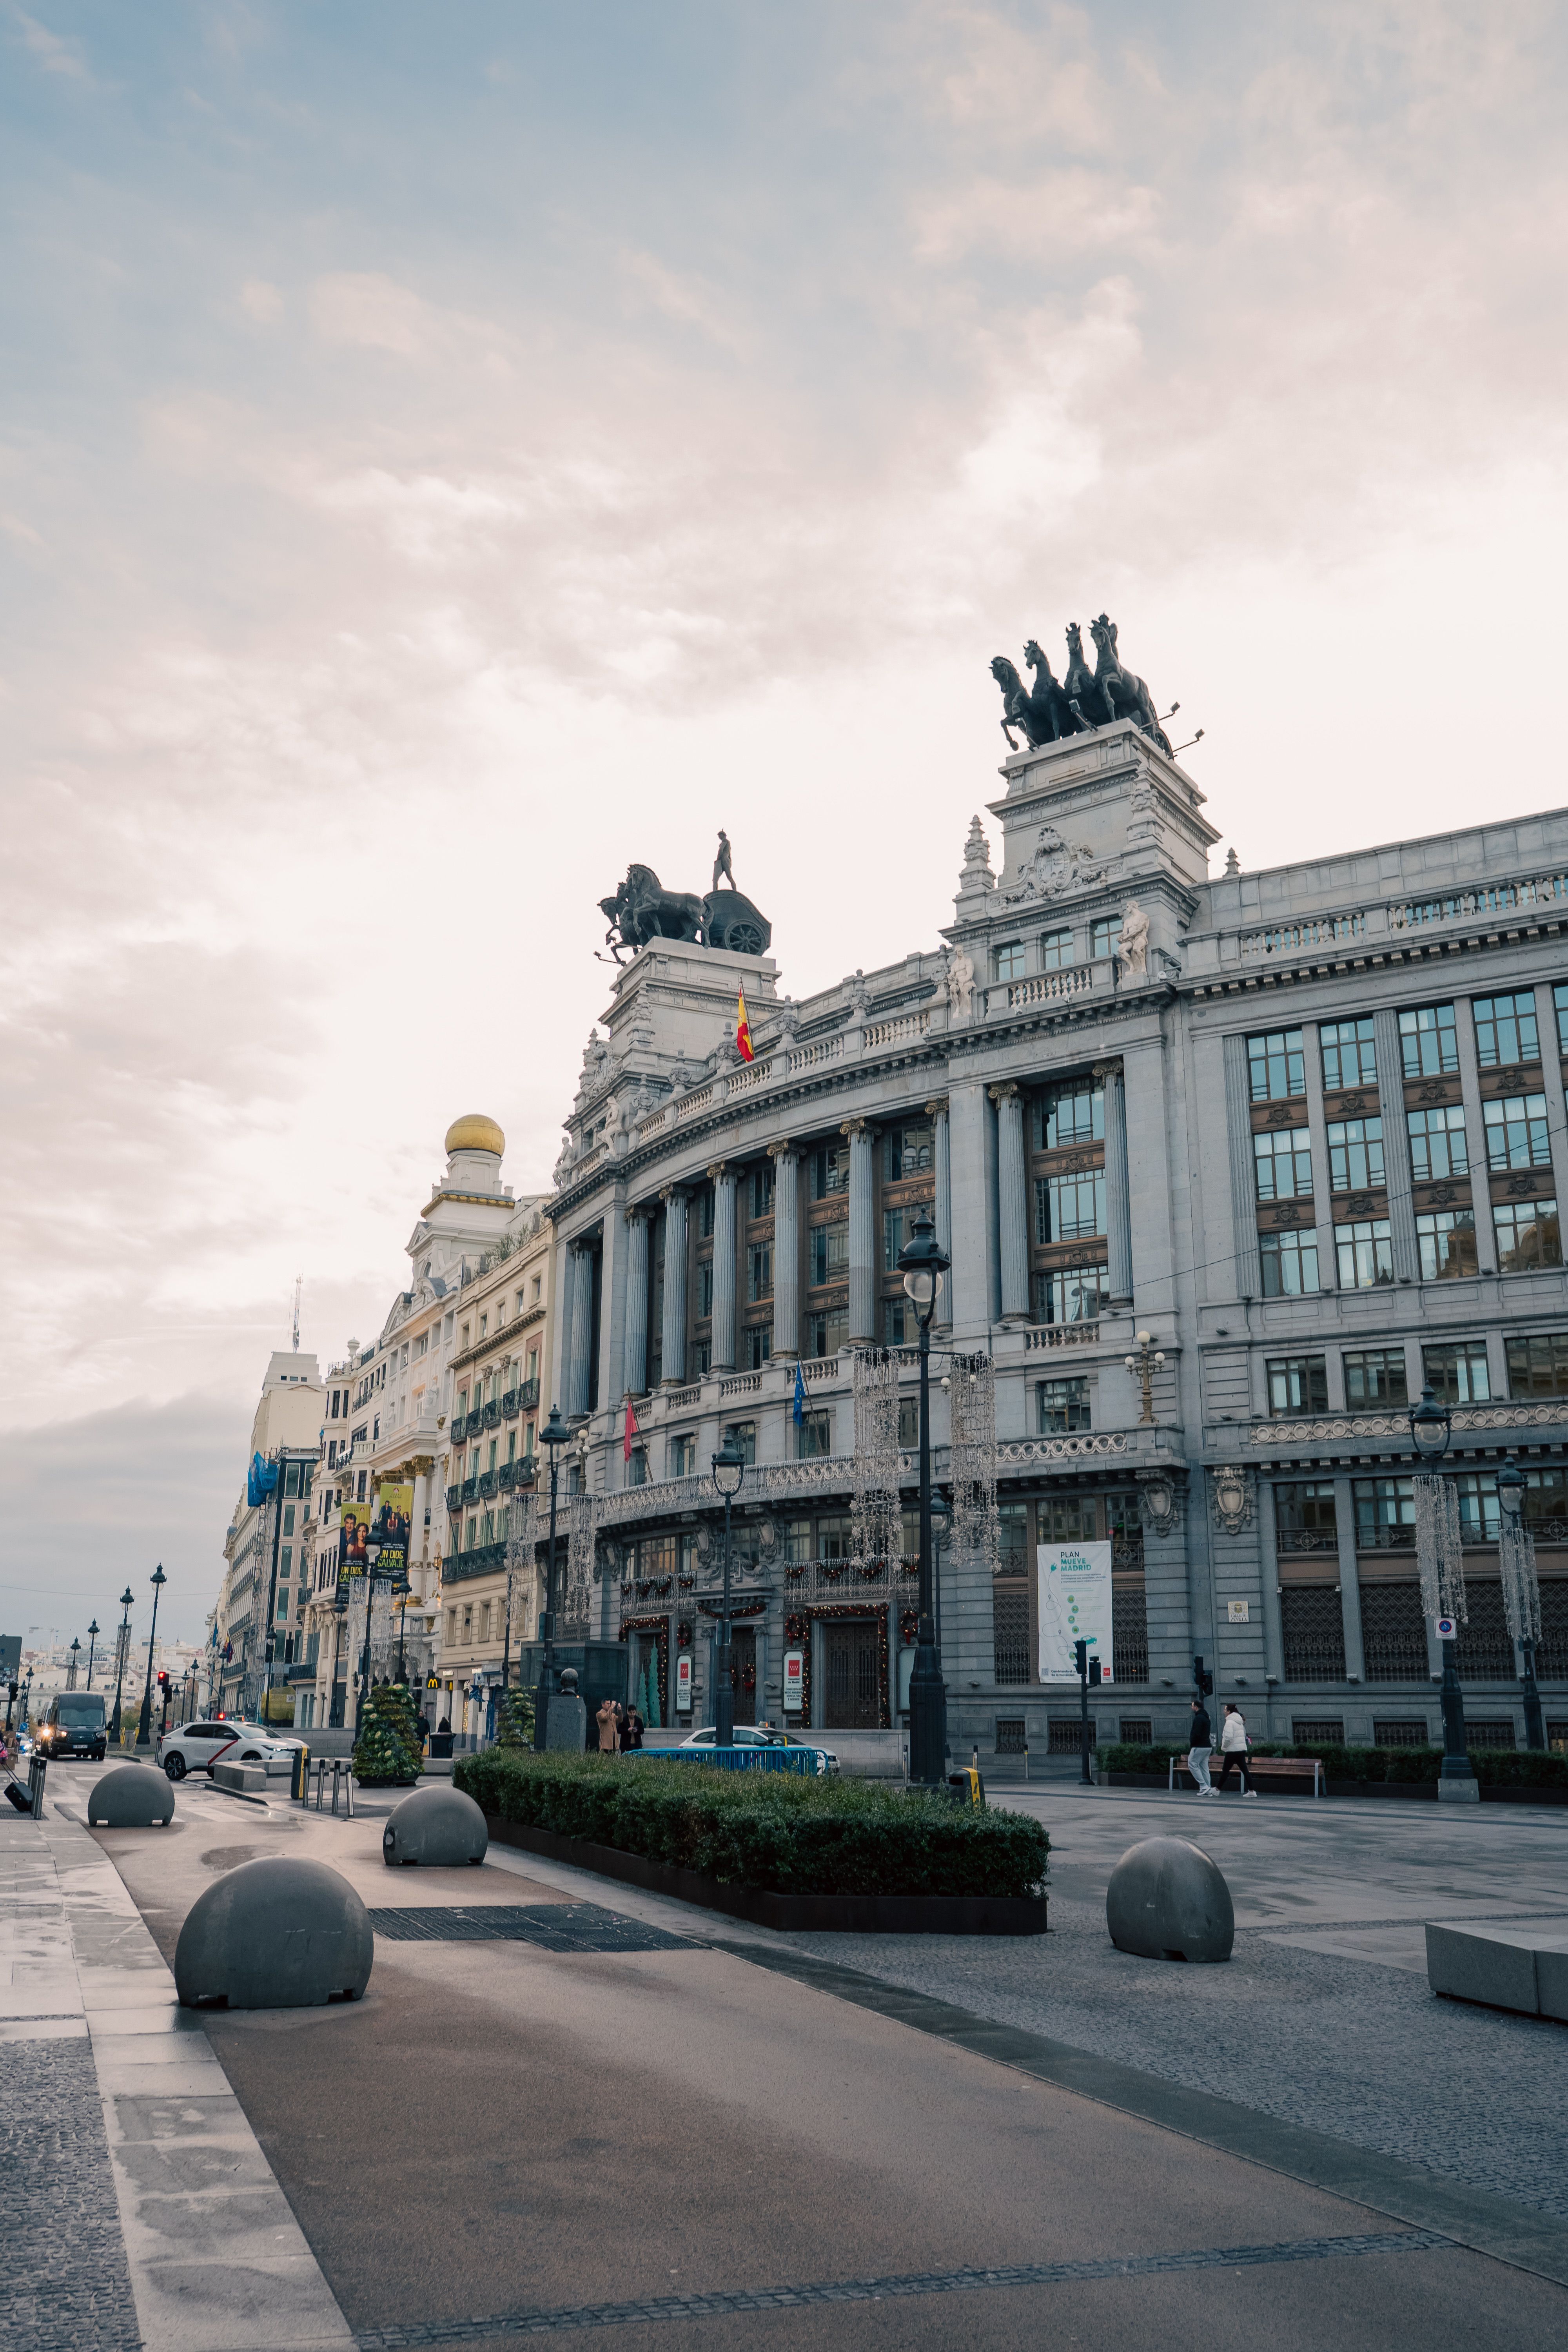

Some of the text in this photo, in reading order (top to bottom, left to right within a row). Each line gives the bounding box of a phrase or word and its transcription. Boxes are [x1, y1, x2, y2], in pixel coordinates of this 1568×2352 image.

[390, 1550, 403, 1559] DIOS
[377, 1558, 404, 1568] SALVAJE
[341, 1566, 363, 1575] UN DIOS
